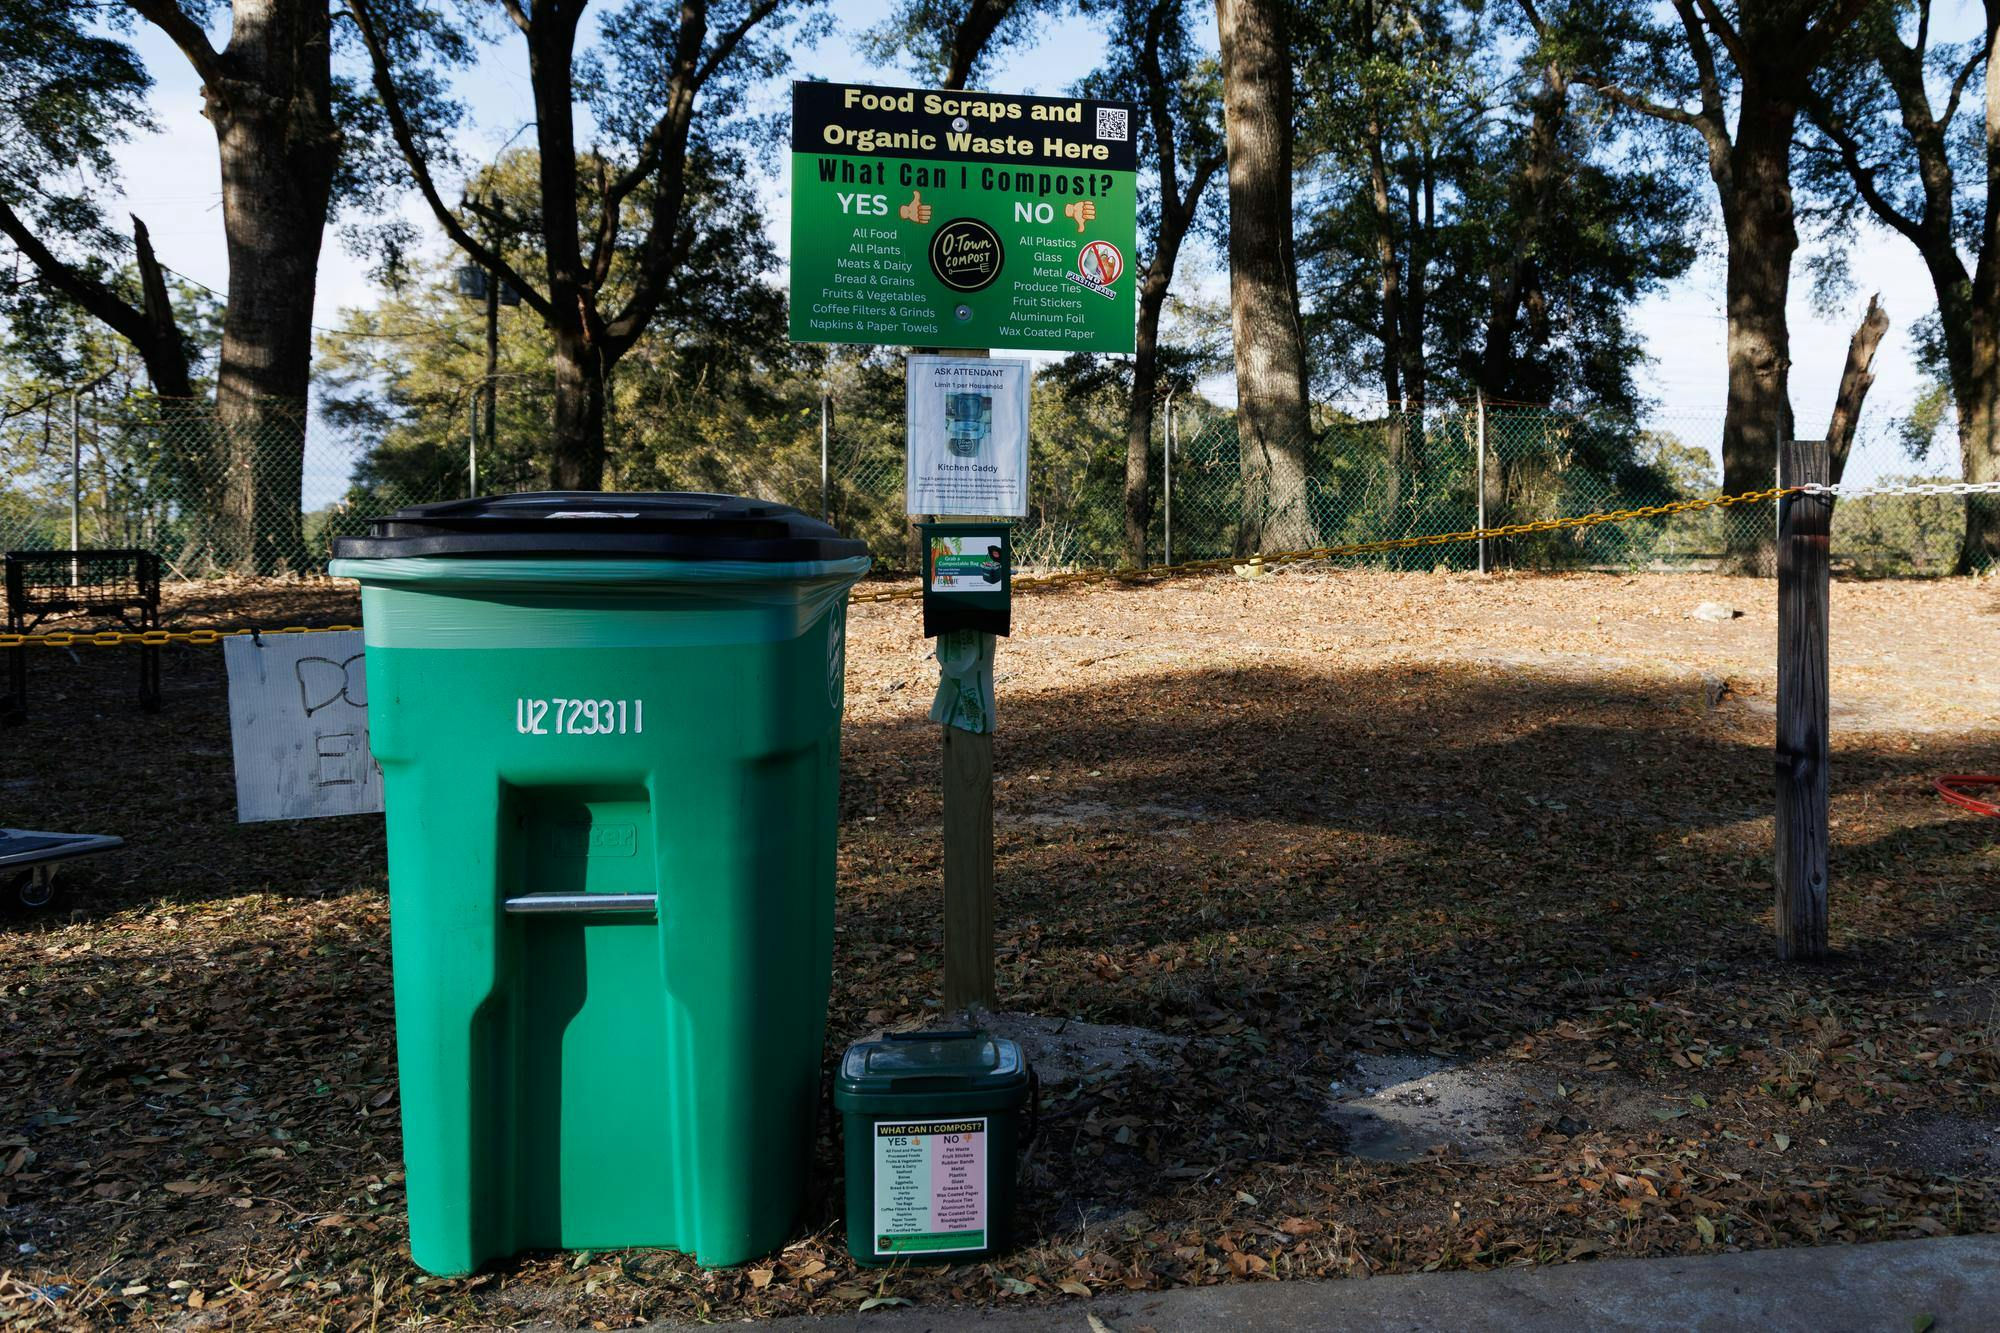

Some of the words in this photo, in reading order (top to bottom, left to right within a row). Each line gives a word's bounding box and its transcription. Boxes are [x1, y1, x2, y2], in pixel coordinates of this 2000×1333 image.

[844, 89, 914, 112] Food
[924, 94, 1022, 122] Scraps
[1031, 103, 1082, 123] and
[823, 124, 936, 152] Organic
[945, 132, 1034, 155] Waste
[1043, 138, 1109, 160] Here
[818, 158, 885, 185] What
[900, 163, 946, 189] Can
[961, 166, 967, 189] I
[982, 167, 1113, 197] Compost?
[837, 193, 888, 216] YES
[1014, 201, 1054, 224] NO
[853, 228, 867, 238] All
[870, 229, 897, 239] Food
[1020, 236, 1033, 246] All
[1037, 237, 1077, 248] Plastics
[849, 244, 863, 253] All
[867, 244, 900, 254] Plants
[1034, 252, 1062, 262] Glass
[837, 259, 870, 269] Meats
[873, 260, 880, 269] &
[884, 261, 912, 273] Dairy
[1033, 267, 1062, 277] Metal
[835, 274, 866, 283] Bread
[870, 275, 877, 284] &
[880, 276, 914, 286] Grains
[1014, 282, 1058, 292] Produce
[1061, 283, 1081, 293] Ties
[822, 289, 853, 299] Fruits
[857, 290, 864, 299] &
[867, 291, 926, 302] Vegetables
[1013, 297, 1037, 306] Fruit
[1040, 298, 1082, 308] Stickers
[813, 304, 849, 314] Coffee
[853, 305, 886, 316] Filters
[889, 307, 897, 316] &
[900, 307, 935, 317] Grinds
[1010, 312, 1062, 322] Aluminum
[1066, 314, 1084, 324] Foil
[810, 319, 853, 331] Napkins
[856, 321, 864, 330] &
[867, 321, 898, 332] Paper
[902, 323, 938, 333] Towels
[999, 326, 1020, 336] Wax
[1024, 327, 1061, 337] Coated
[1064, 328, 1094, 340] Paper
[934, 368, 952, 376] ASK
[954, 368, 1004, 377] ATTENDANT
[938, 464, 969, 472] Kitchen
[972, 464, 998, 473] Caddy
[517, 698, 643, 735] U2729311
[880, 1126, 906, 1134] WHAT
[934, 1122, 982, 1132] COMPOST?
[888, 1137, 907, 1146] YES
[944, 1135, 959, 1144] NO
